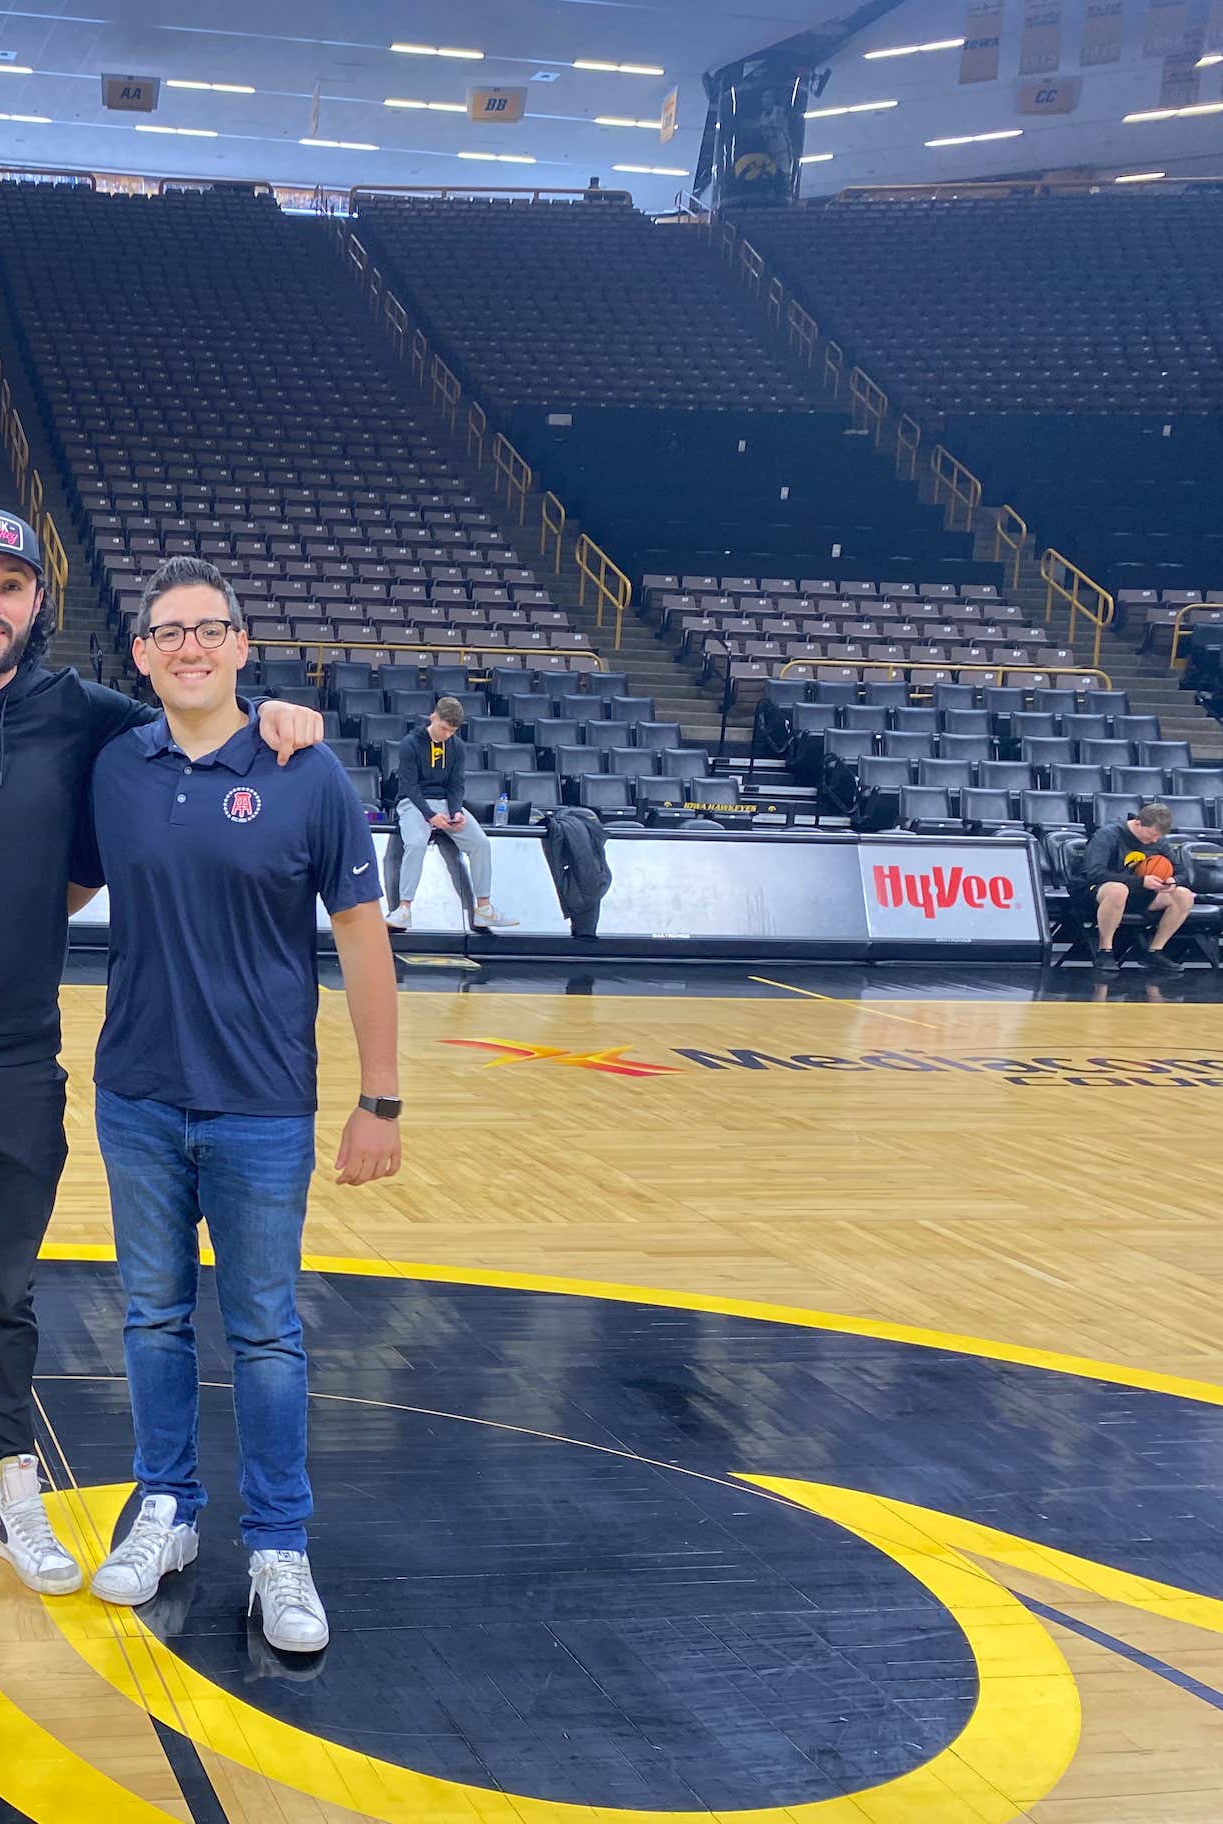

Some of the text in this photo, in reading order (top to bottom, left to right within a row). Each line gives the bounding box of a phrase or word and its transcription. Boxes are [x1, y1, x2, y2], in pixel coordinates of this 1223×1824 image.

[120, 87, 141, 100] AA
[1034, 88, 1058, 104] CC
[484, 97, 508, 111] BB
[707, 802, 757, 812] HAWKEYES
